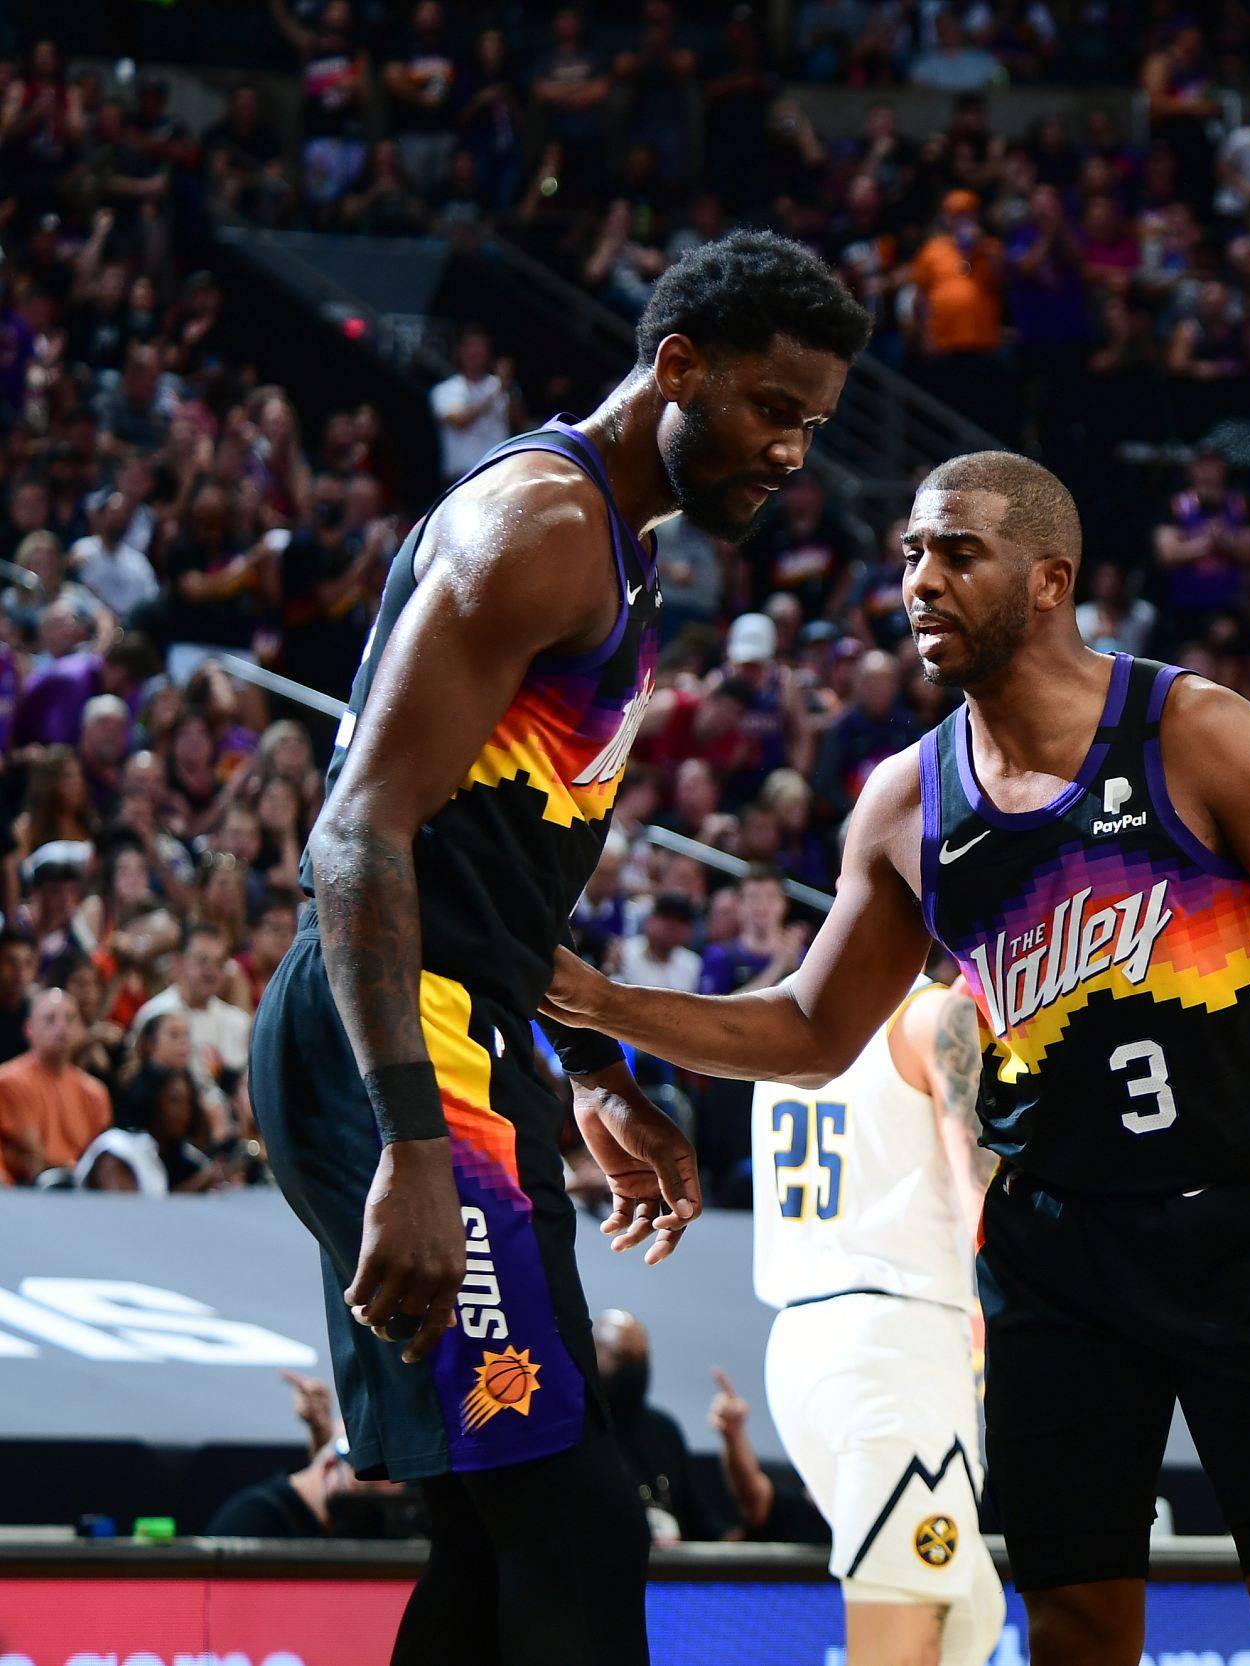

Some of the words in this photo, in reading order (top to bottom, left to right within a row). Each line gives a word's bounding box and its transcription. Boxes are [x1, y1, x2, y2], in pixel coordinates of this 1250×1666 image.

[1093, 811, 1147, 835] PayPal
[970, 879, 1173, 1037] Valley
[1010, 922, 1046, 958] THE
[1109, 1039, 1177, 1134] 3
[771, 1099, 848, 1221] 25
[457, 1206, 510, 1340] SUNS
